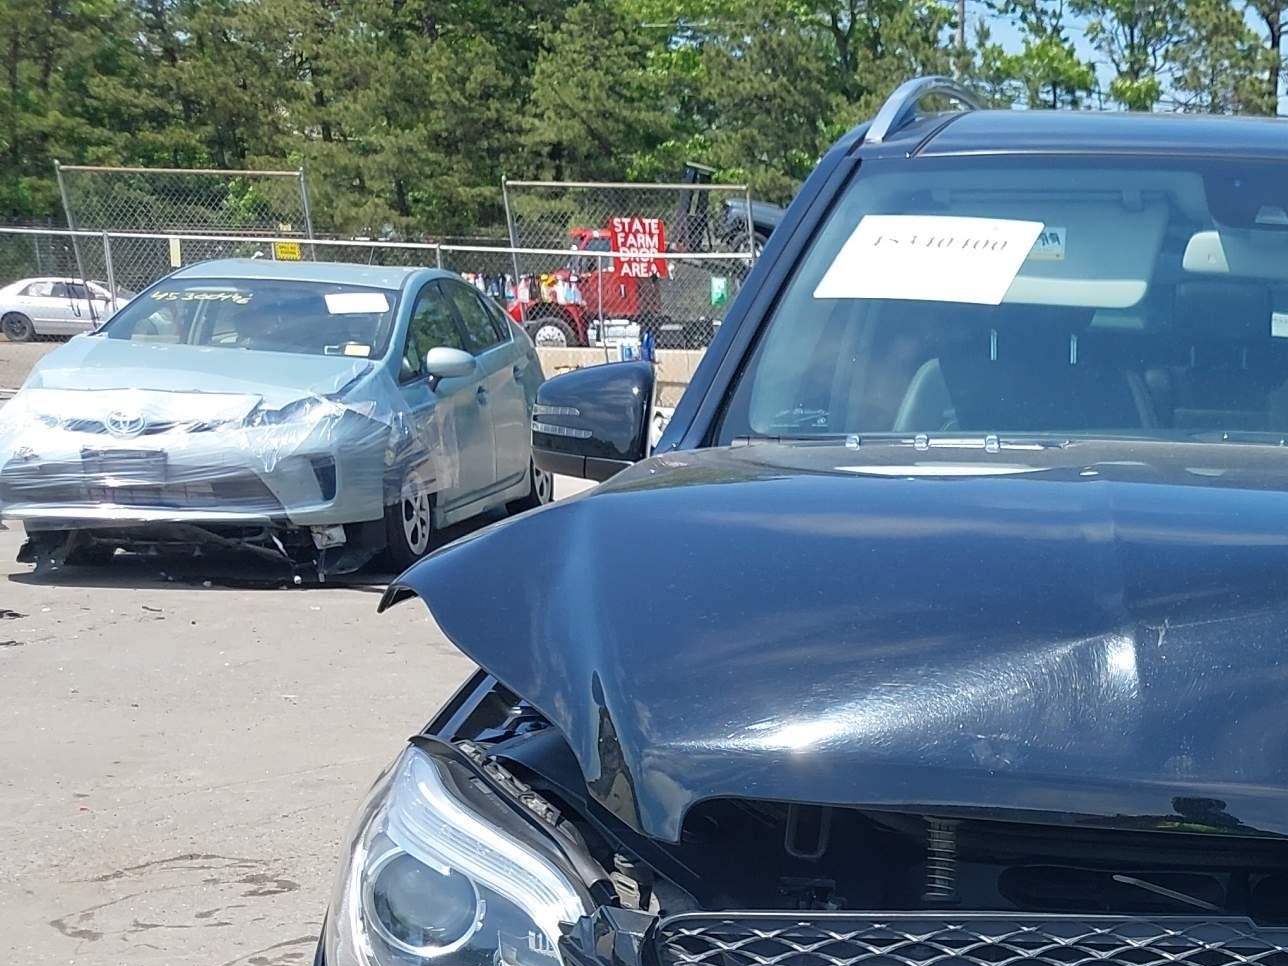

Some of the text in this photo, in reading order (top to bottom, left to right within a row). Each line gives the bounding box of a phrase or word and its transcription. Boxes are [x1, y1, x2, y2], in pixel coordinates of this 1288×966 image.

[613, 217, 660, 233] STATE
[617, 232, 659, 248] FARM
[619, 246, 659, 262] DROP
[620, 261, 660, 277] AREA
